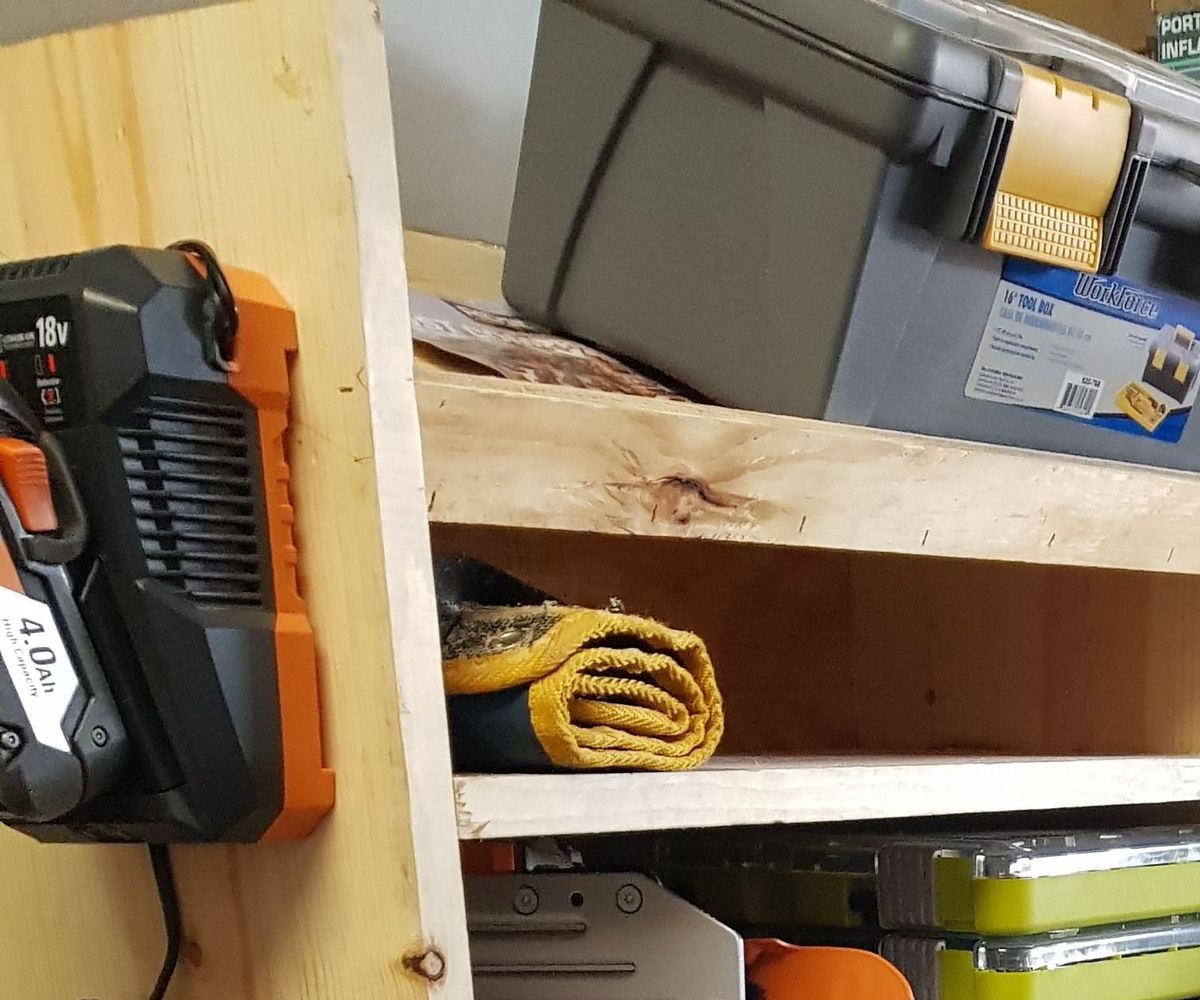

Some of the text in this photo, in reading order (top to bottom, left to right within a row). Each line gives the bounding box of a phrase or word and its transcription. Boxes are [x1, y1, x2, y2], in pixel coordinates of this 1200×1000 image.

[1018, 293, 1037, 313] TOOL
[1037, 299, 1056, 317] BOX
[19, 617, 57, 694] 4.0Ah
